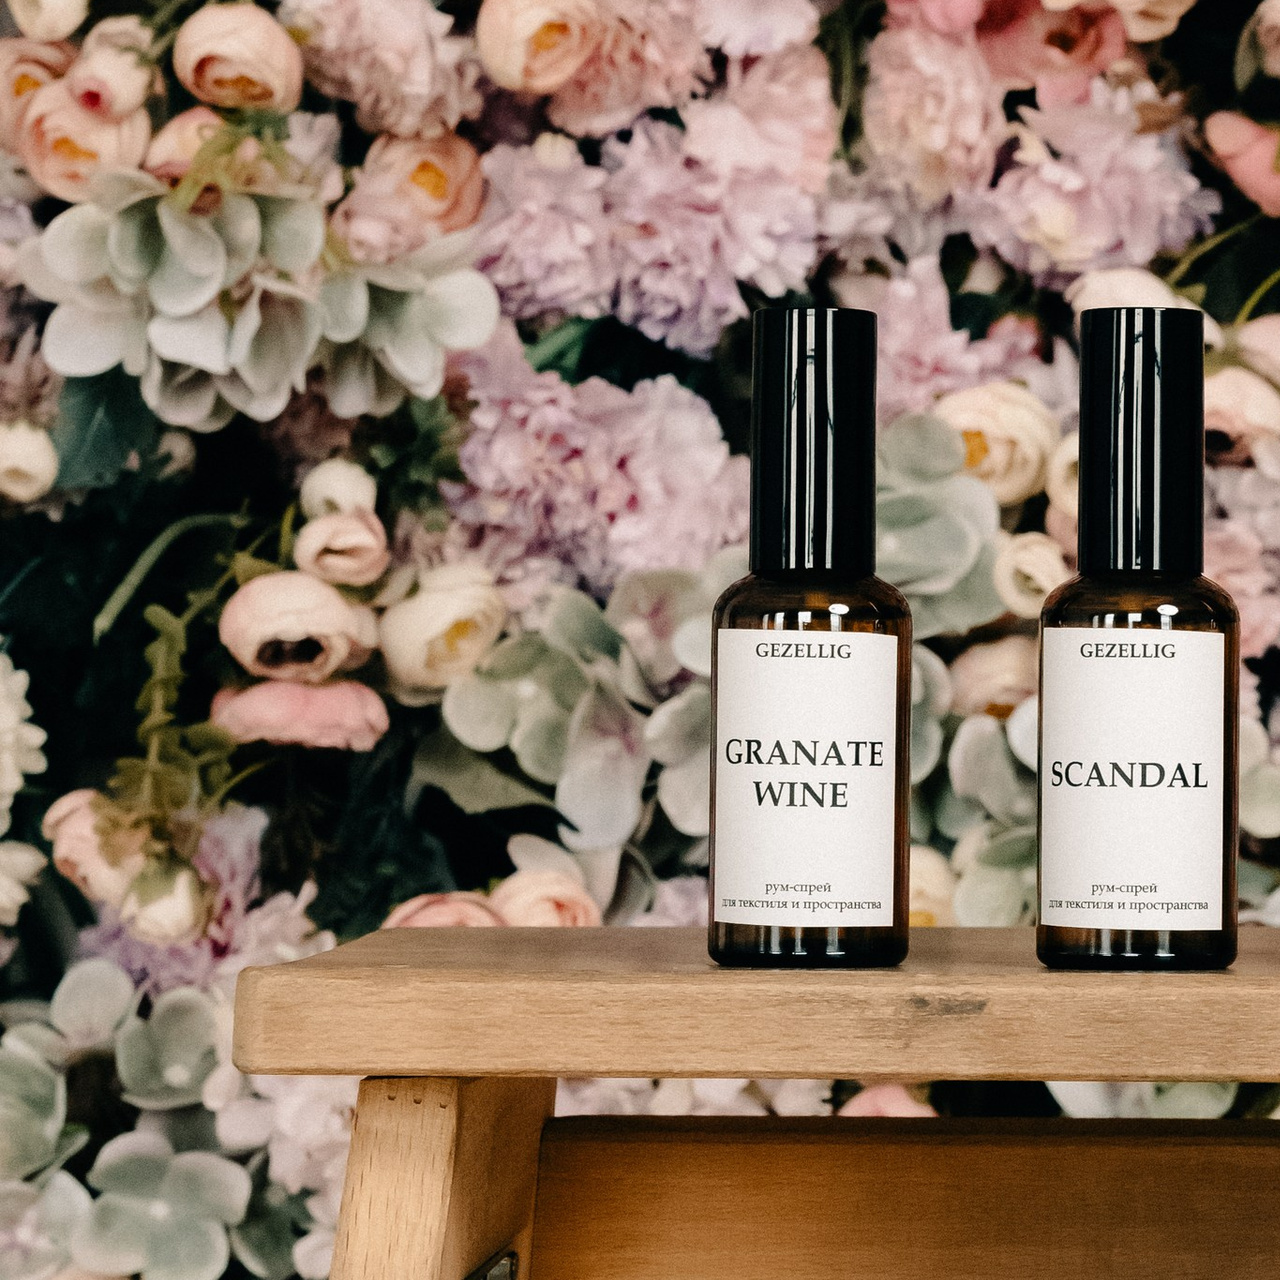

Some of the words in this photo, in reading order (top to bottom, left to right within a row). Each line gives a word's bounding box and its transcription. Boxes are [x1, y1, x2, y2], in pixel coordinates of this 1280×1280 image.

[755, 642, 852, 659] GEZELLIG
[1080, 642, 1176, 659] GEZELLIG
[725, 738, 884, 767] GRANATE
[1051, 760, 1209, 788] SCANDAL
[754, 780, 848, 808] WINE
[765, 882, 831, 895] рум-спрей
[1092, 882, 1157, 895] рум-спрей
[722, 898, 736, 908] для
[739, 899, 788, 910] текстиля
[791, 900, 800, 910] и
[803, 900, 882, 913] пространства
[1049, 899, 1063, 909] для
[1065, 900, 1114, 910] текстиля
[1117, 901, 1126, 910] и
[1129, 900, 1208, 913] пространства
